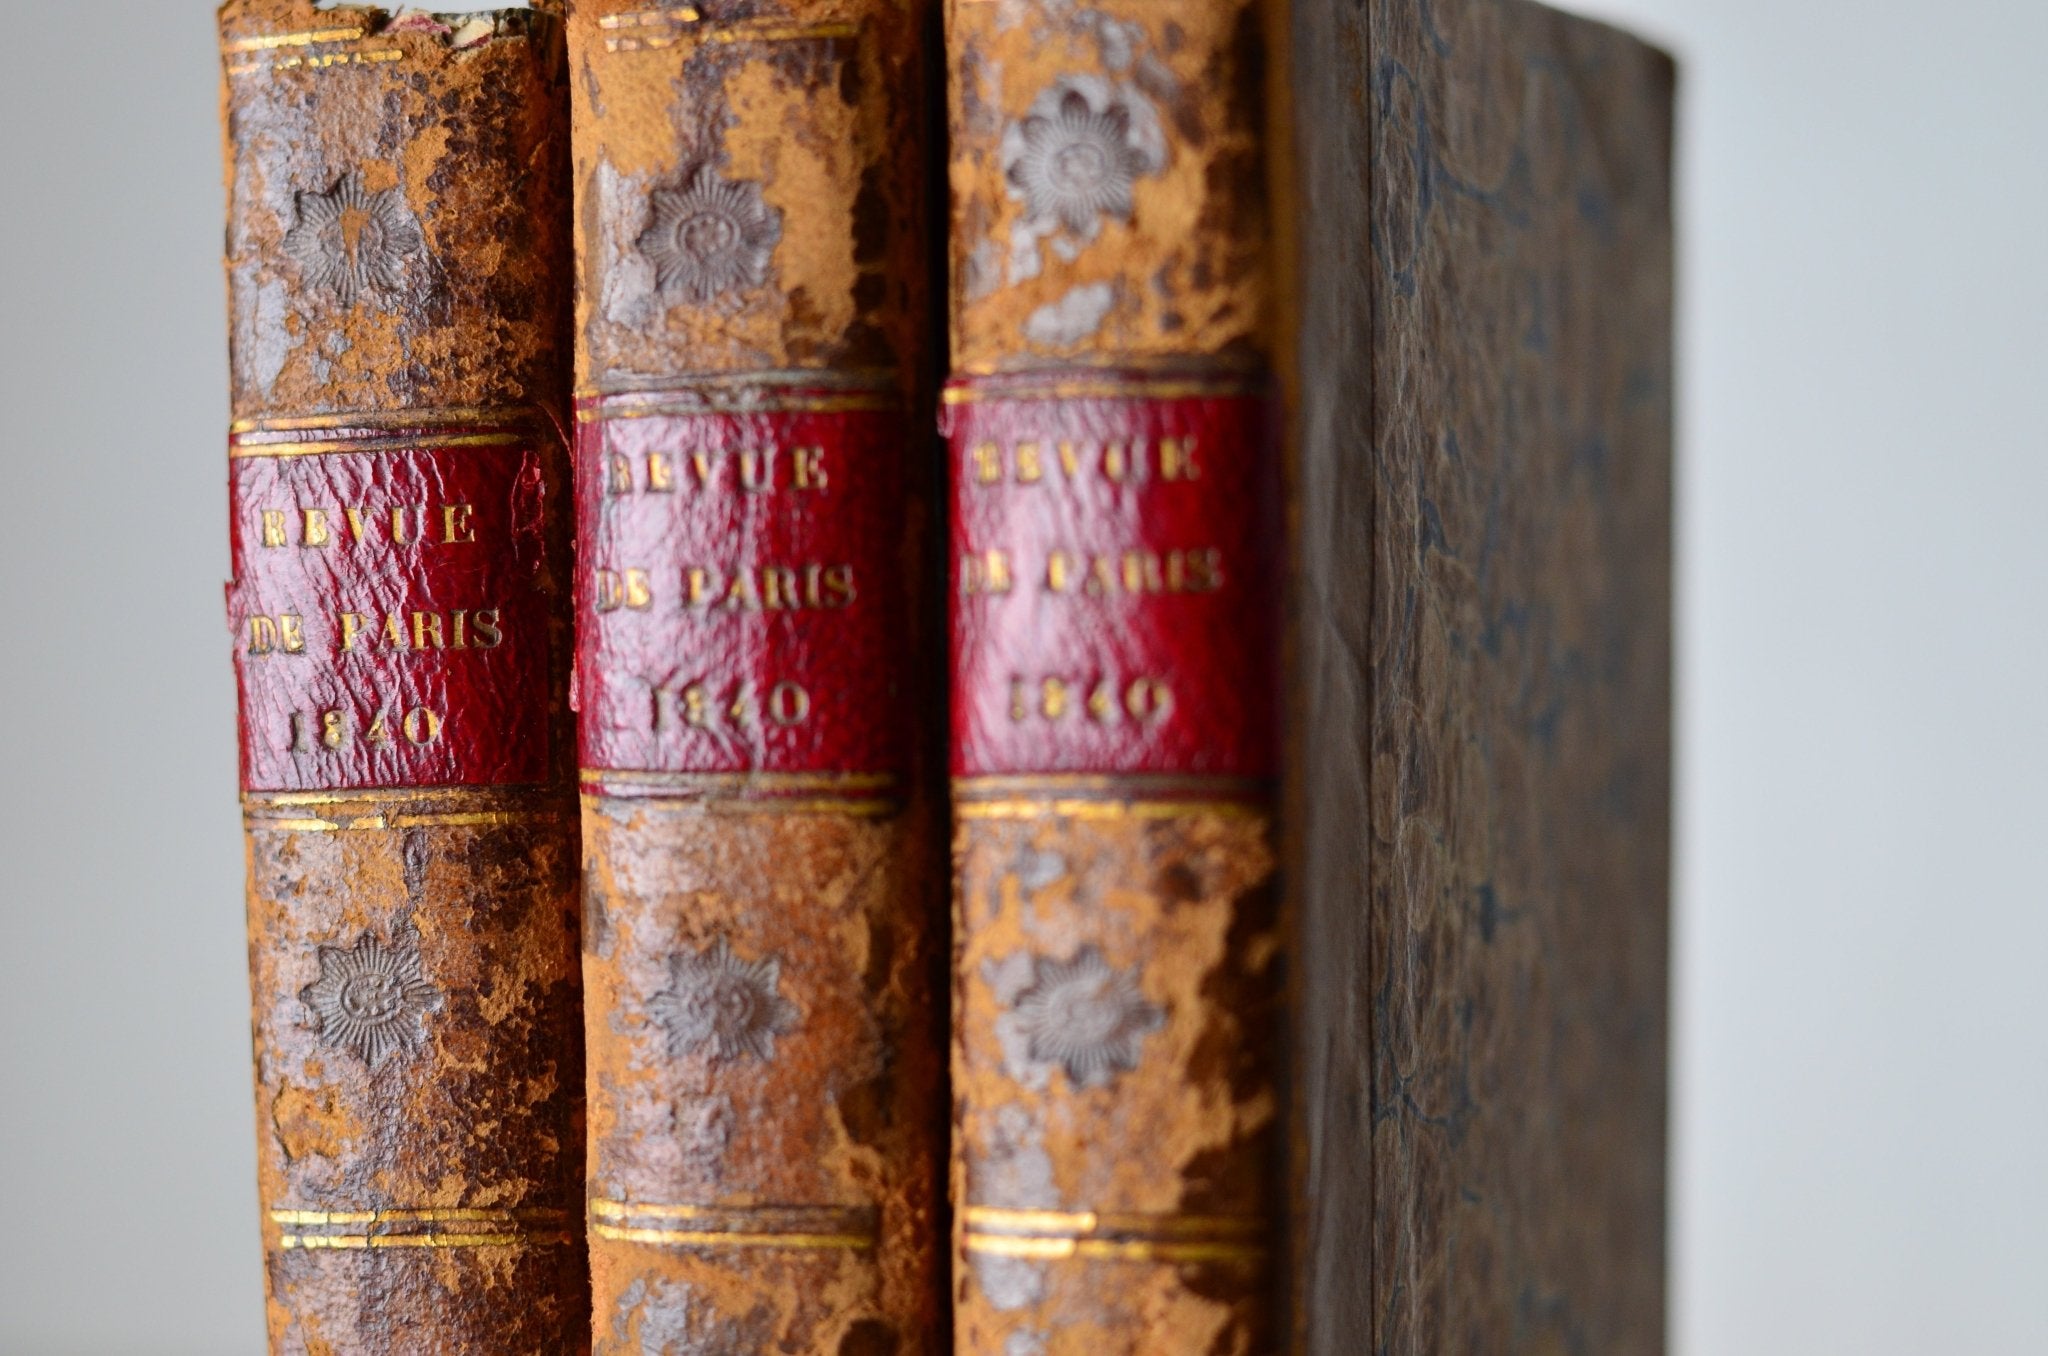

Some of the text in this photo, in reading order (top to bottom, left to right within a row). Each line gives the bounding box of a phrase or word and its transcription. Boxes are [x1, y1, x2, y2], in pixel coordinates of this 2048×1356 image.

[261, 504, 476, 547] REVUE
[684, 563, 857, 611] PARIS
[249, 608, 503, 655] DE PARIS
[289, 706, 440, 753] 1840
